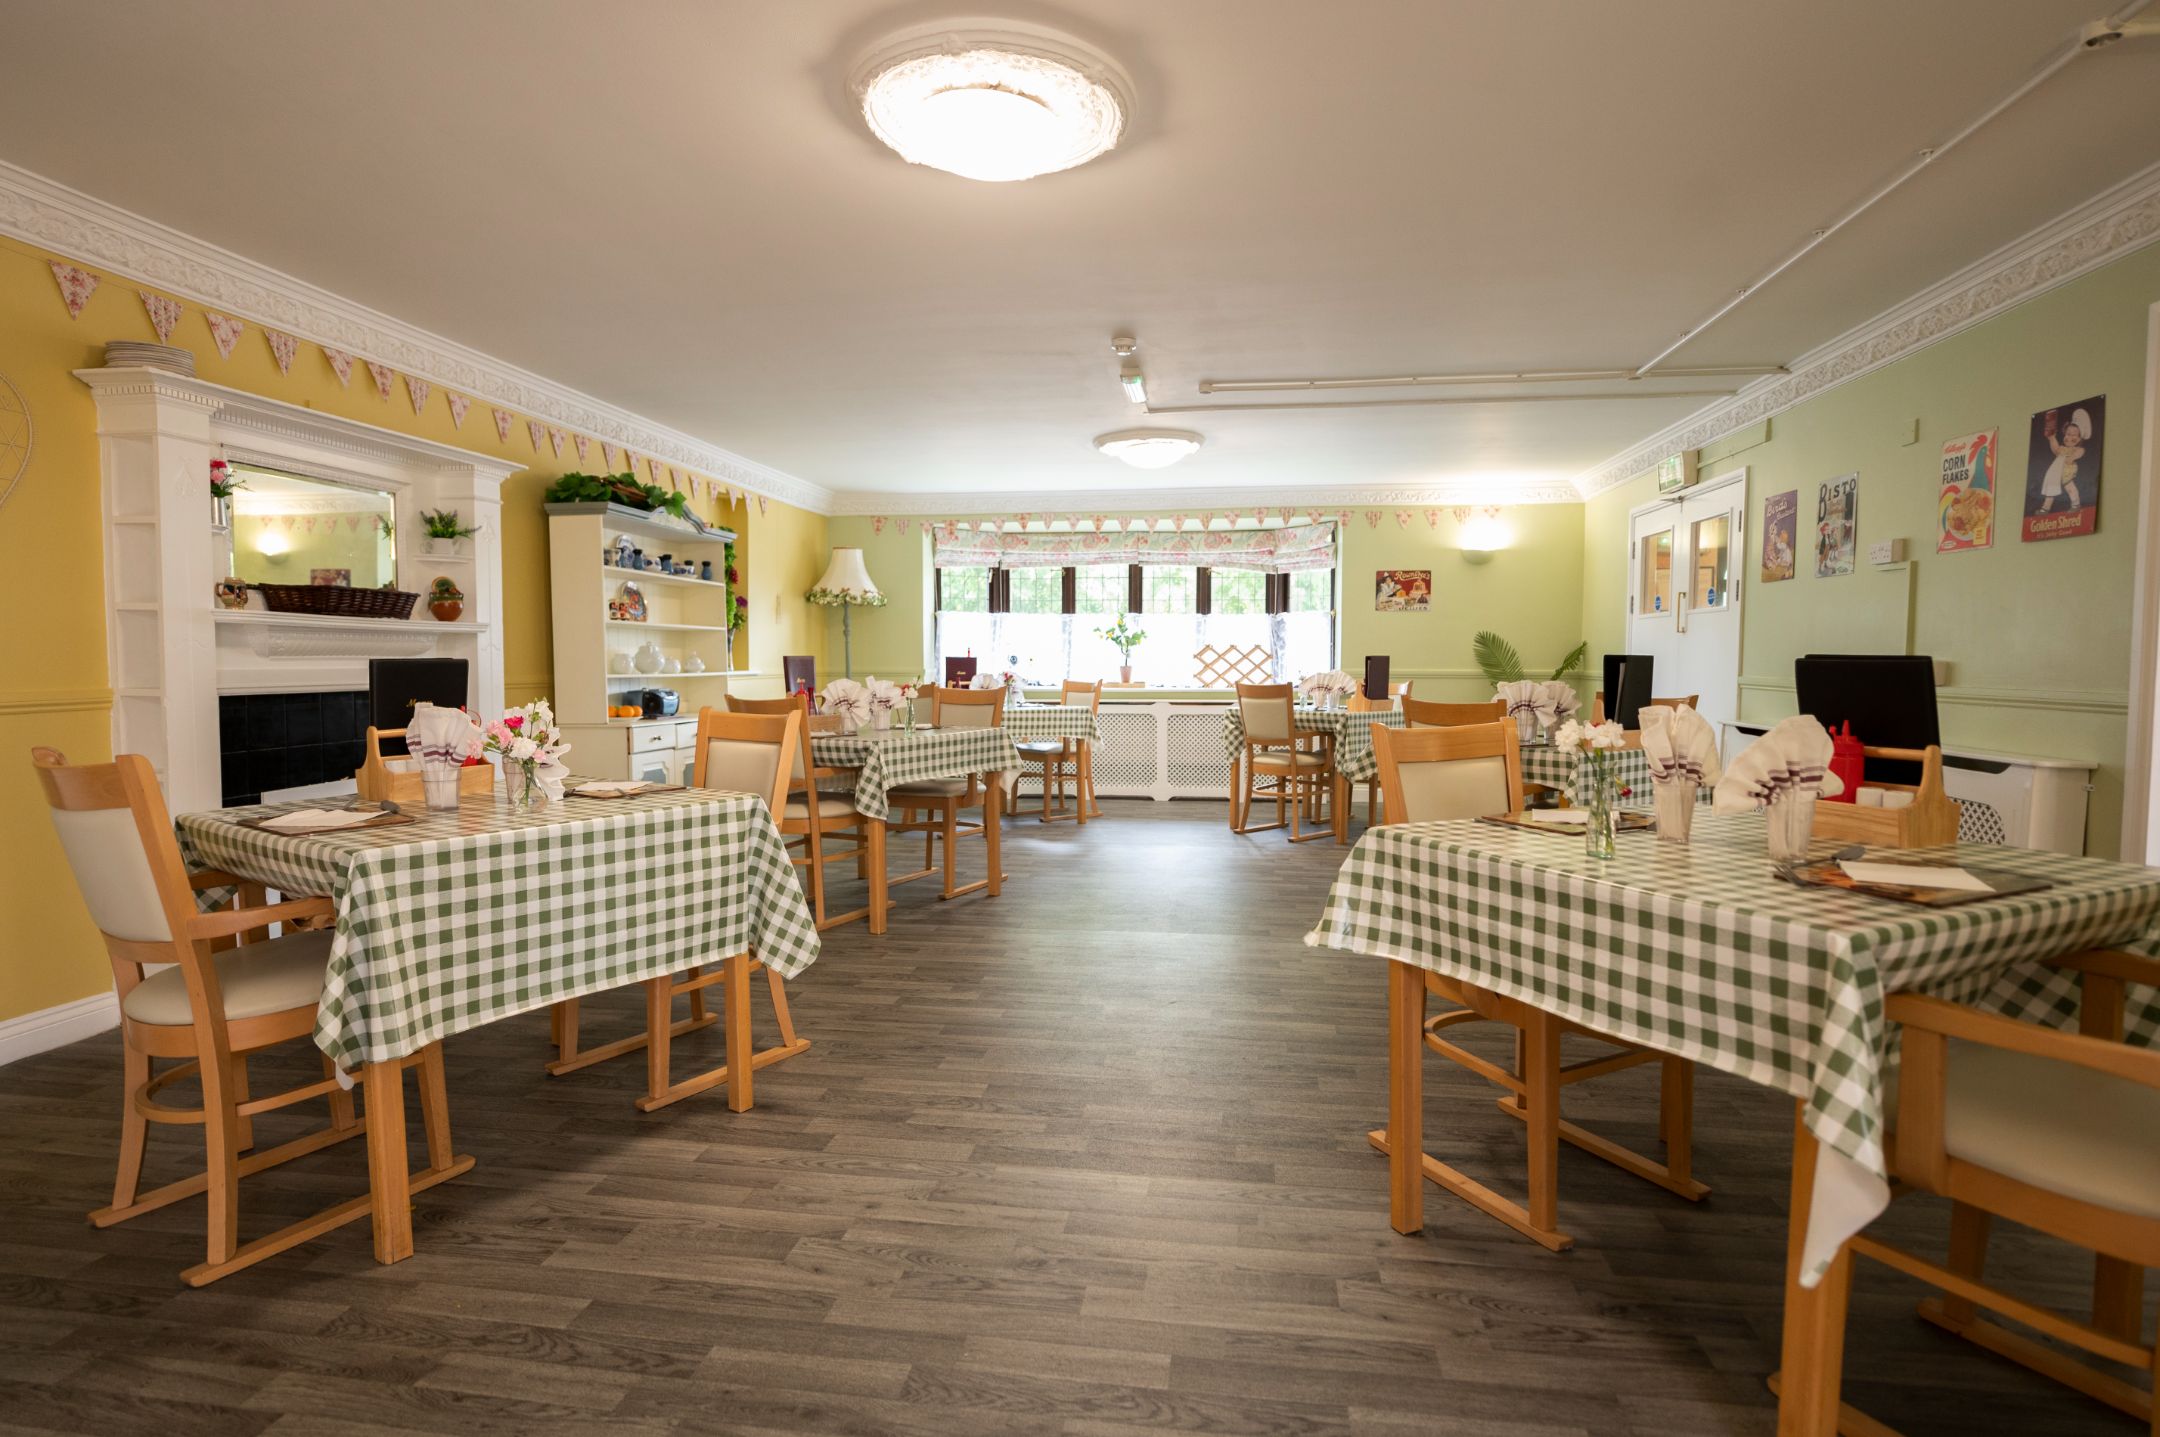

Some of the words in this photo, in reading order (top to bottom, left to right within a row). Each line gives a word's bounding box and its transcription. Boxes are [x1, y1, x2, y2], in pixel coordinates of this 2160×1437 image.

[1943, 454, 1966, 472] CORN
[1942, 469, 1969, 485] FLAKES
[1817, 478, 1856, 524] BISTO
[2031, 518, 2057, 532] Golden
[2057, 512, 2081, 528] Shred
